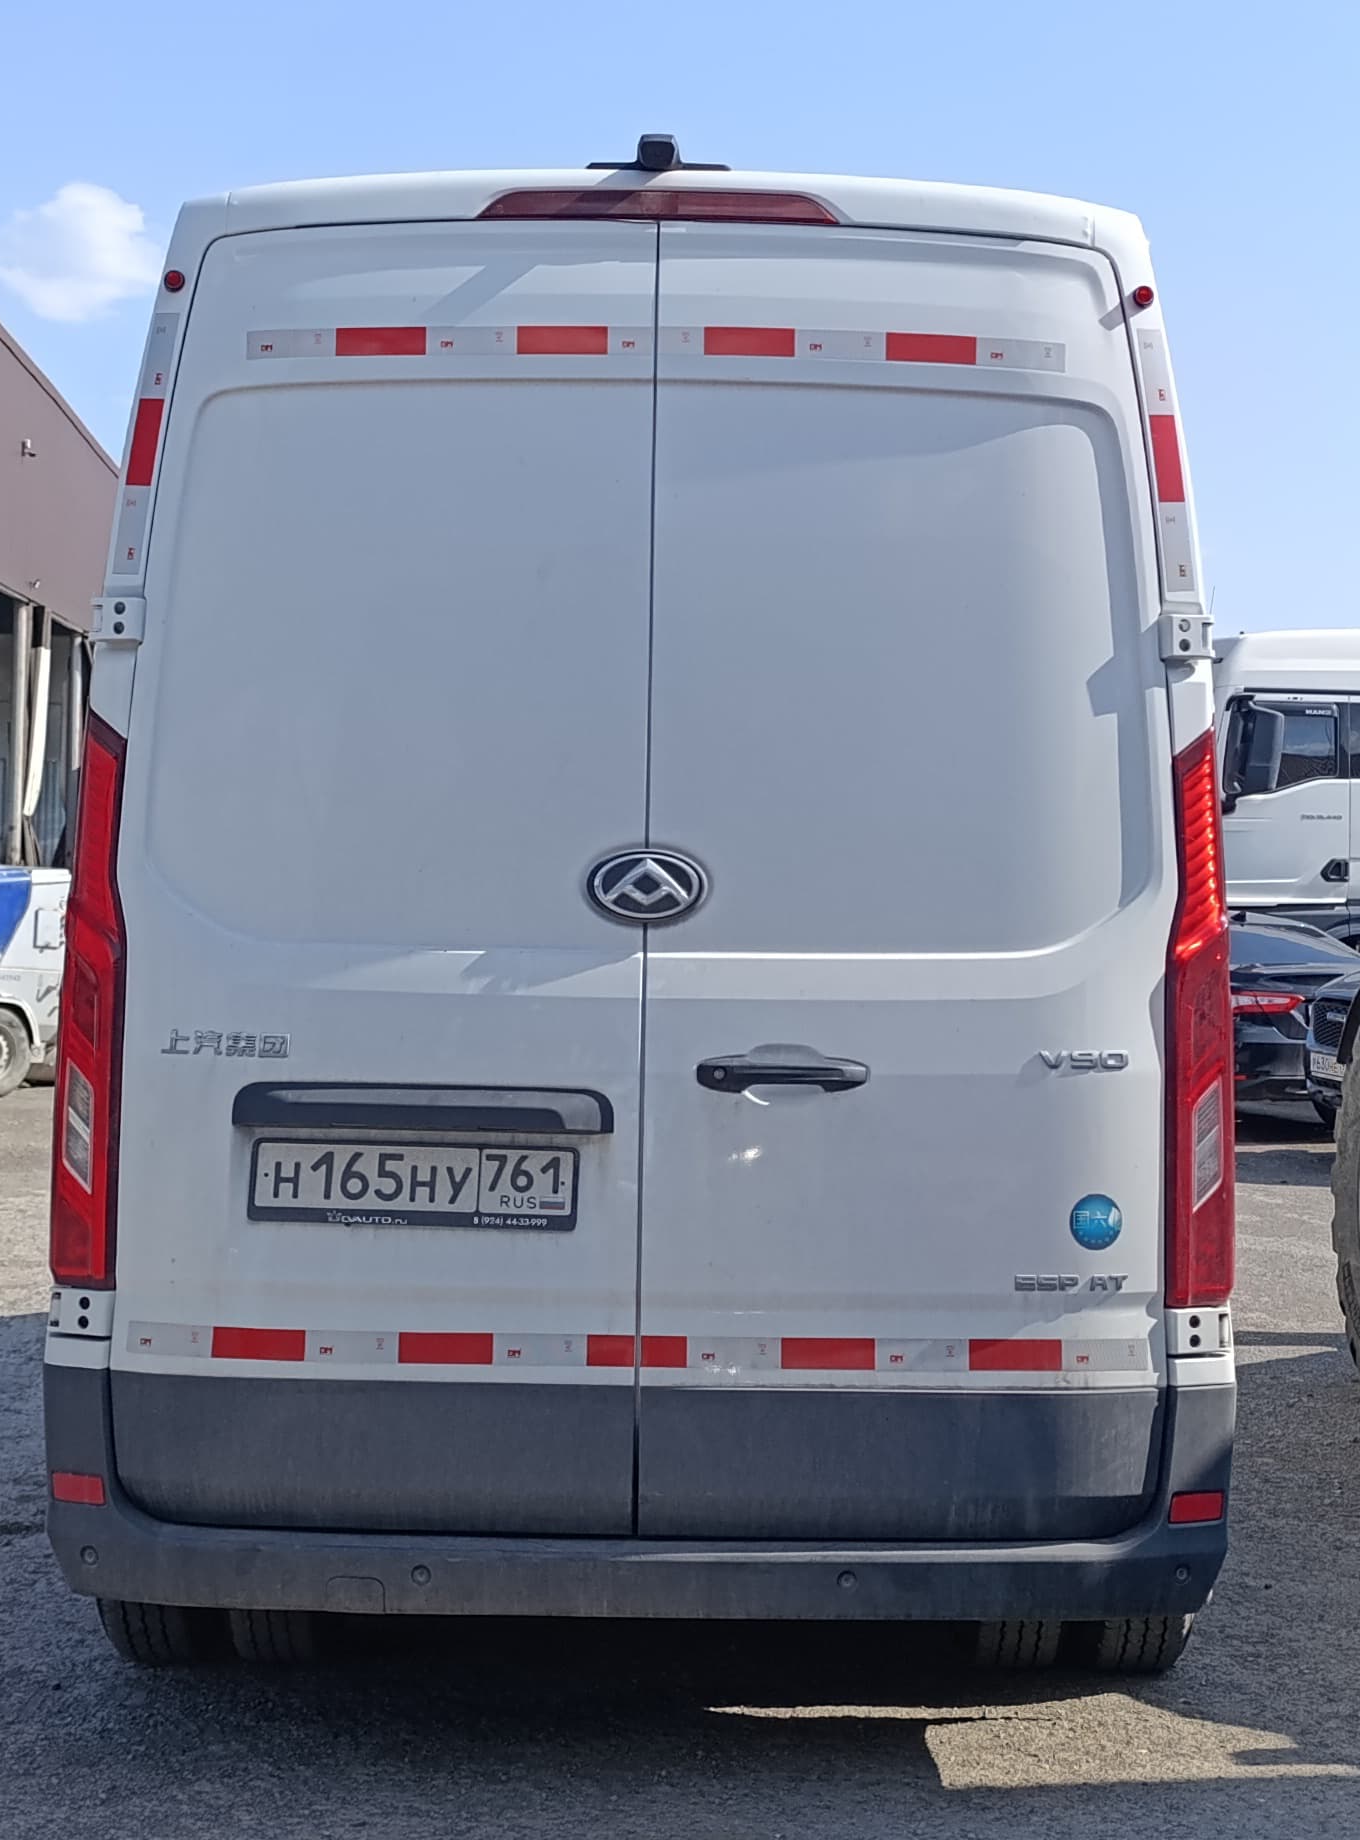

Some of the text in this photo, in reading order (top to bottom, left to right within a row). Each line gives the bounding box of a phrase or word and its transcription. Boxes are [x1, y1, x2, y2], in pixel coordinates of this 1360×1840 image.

[160, 1028, 291, 1059] 上汽集团
[1039, 1050, 1129, 1070] V90
[272, 1151, 561, 1205] Н165НУ 761
[499, 1196, 537, 1210] RUS
[473, 1216, 479, 1225] 8
[1014, 1273, 1129, 1292] ESP AT
